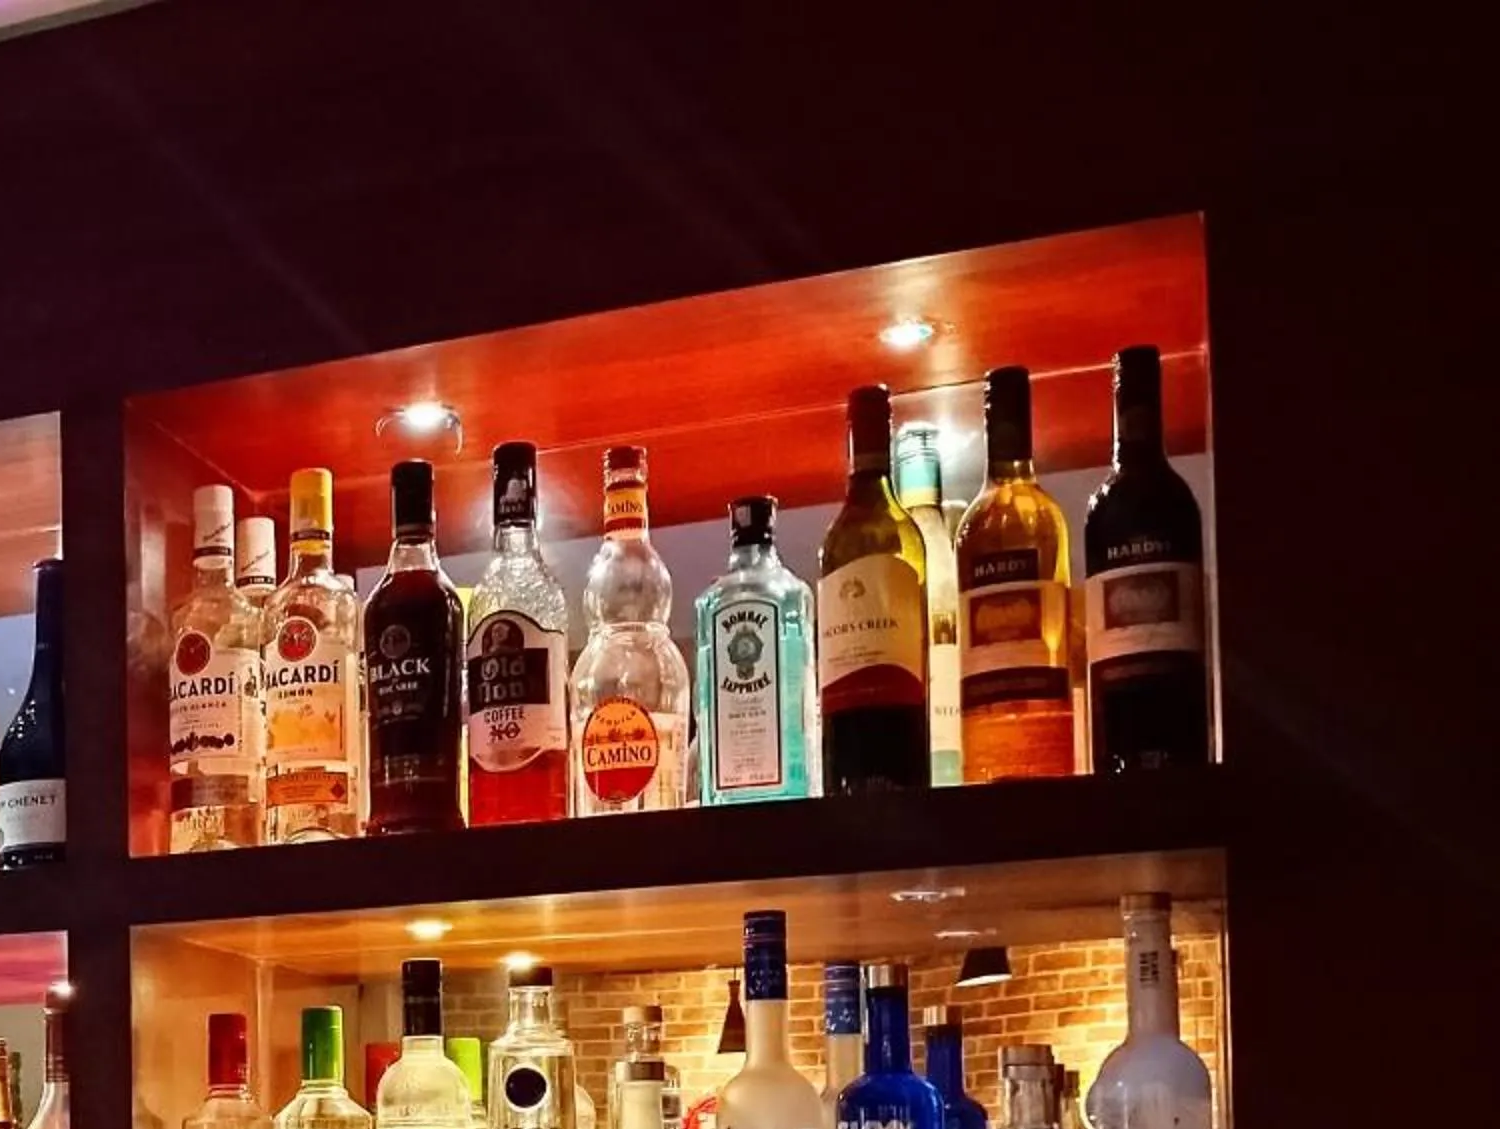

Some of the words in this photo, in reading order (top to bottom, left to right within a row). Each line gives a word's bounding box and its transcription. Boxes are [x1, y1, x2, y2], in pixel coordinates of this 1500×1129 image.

[721, 610, 769, 634] BOMBAY
[369, 657, 431, 683] BLACK
[720, 671, 772, 695] SAPPHIRE
[483, 705, 525, 723] COFFEE
[7, 793, 56, 809] CHENET
